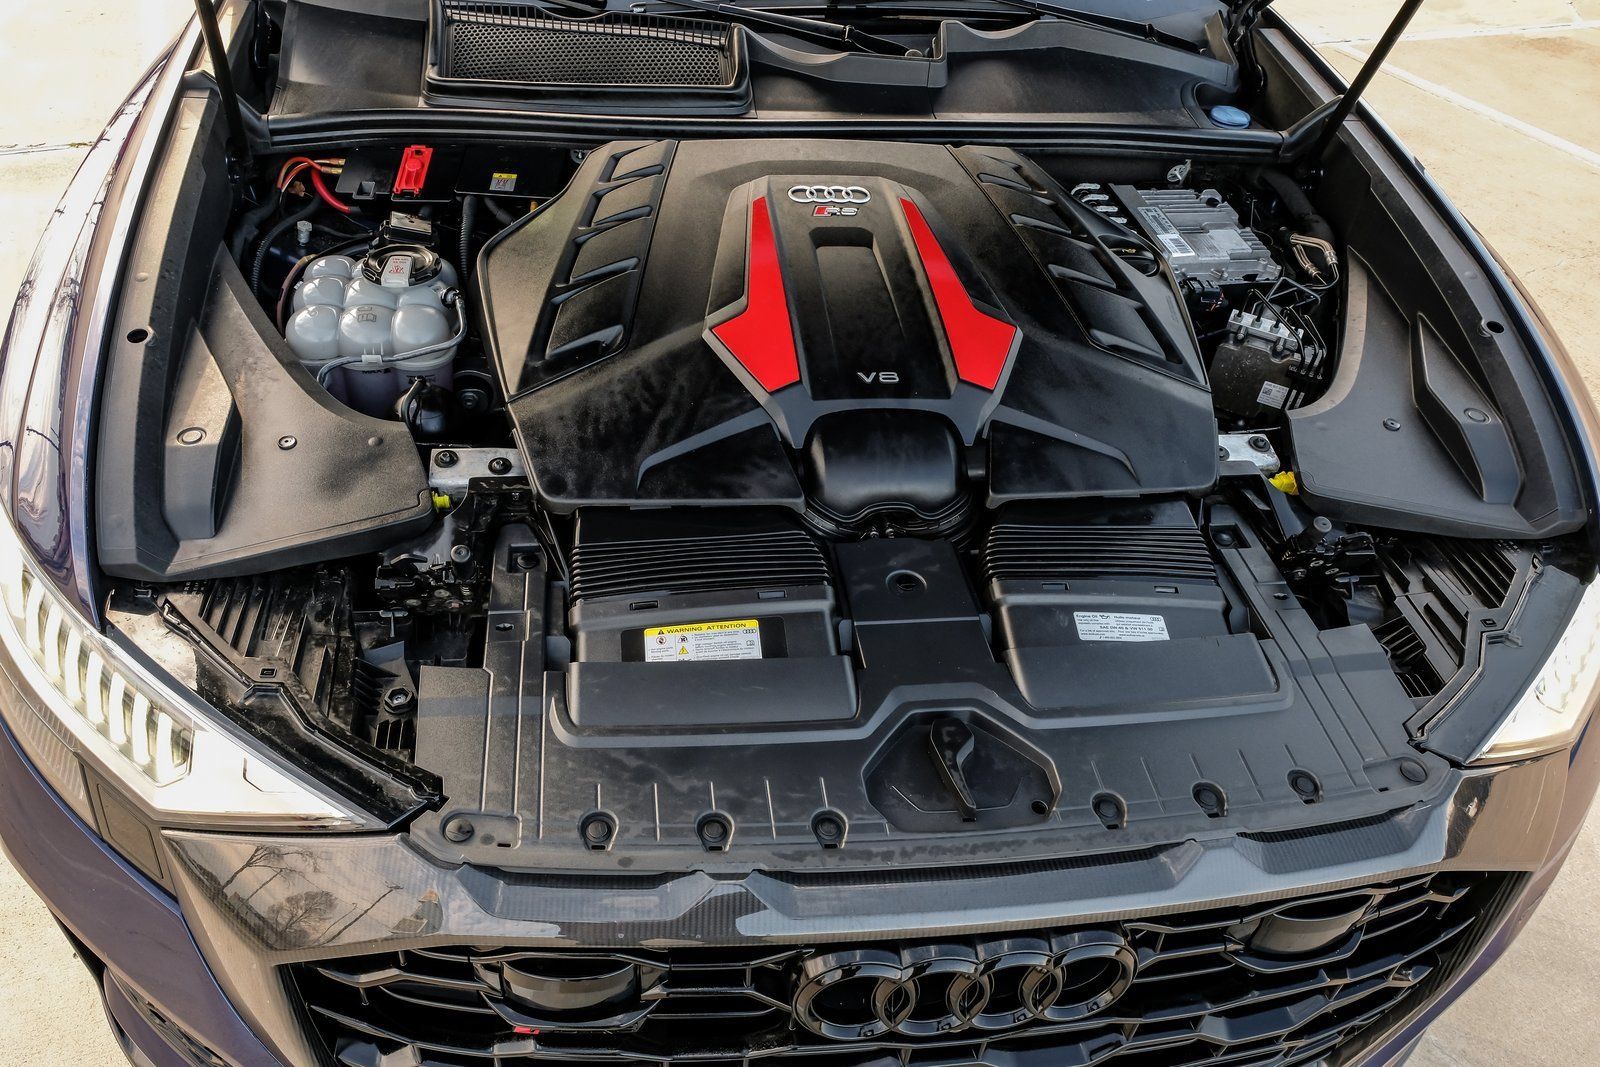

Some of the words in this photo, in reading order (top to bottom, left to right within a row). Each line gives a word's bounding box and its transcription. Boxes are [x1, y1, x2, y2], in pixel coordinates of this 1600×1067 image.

[813, 205, 859, 217] RS
[857, 371, 899, 384] V8
[666, 626, 703, 634] WARNING
[706, 623, 747, 631] ATTENTION
